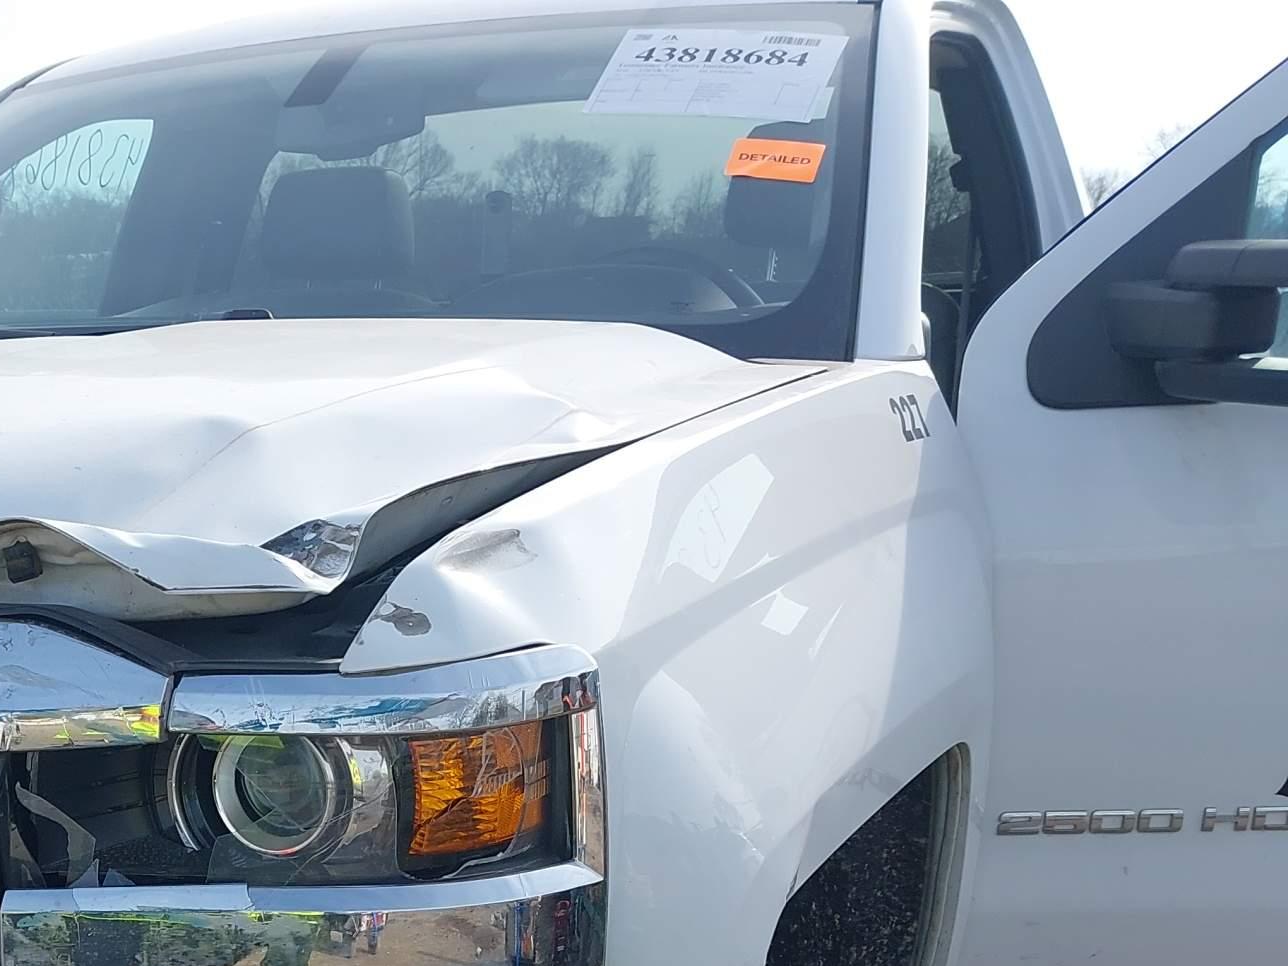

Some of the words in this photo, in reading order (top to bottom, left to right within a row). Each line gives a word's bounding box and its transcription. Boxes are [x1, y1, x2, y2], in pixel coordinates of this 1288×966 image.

[634, 46, 810, 67] 43818684
[738, 152, 812, 166] DETAILED
[889, 393, 931, 442] 227
[996, 808, 1185, 836] 2500
[1200, 806, 1288, 832] HD
